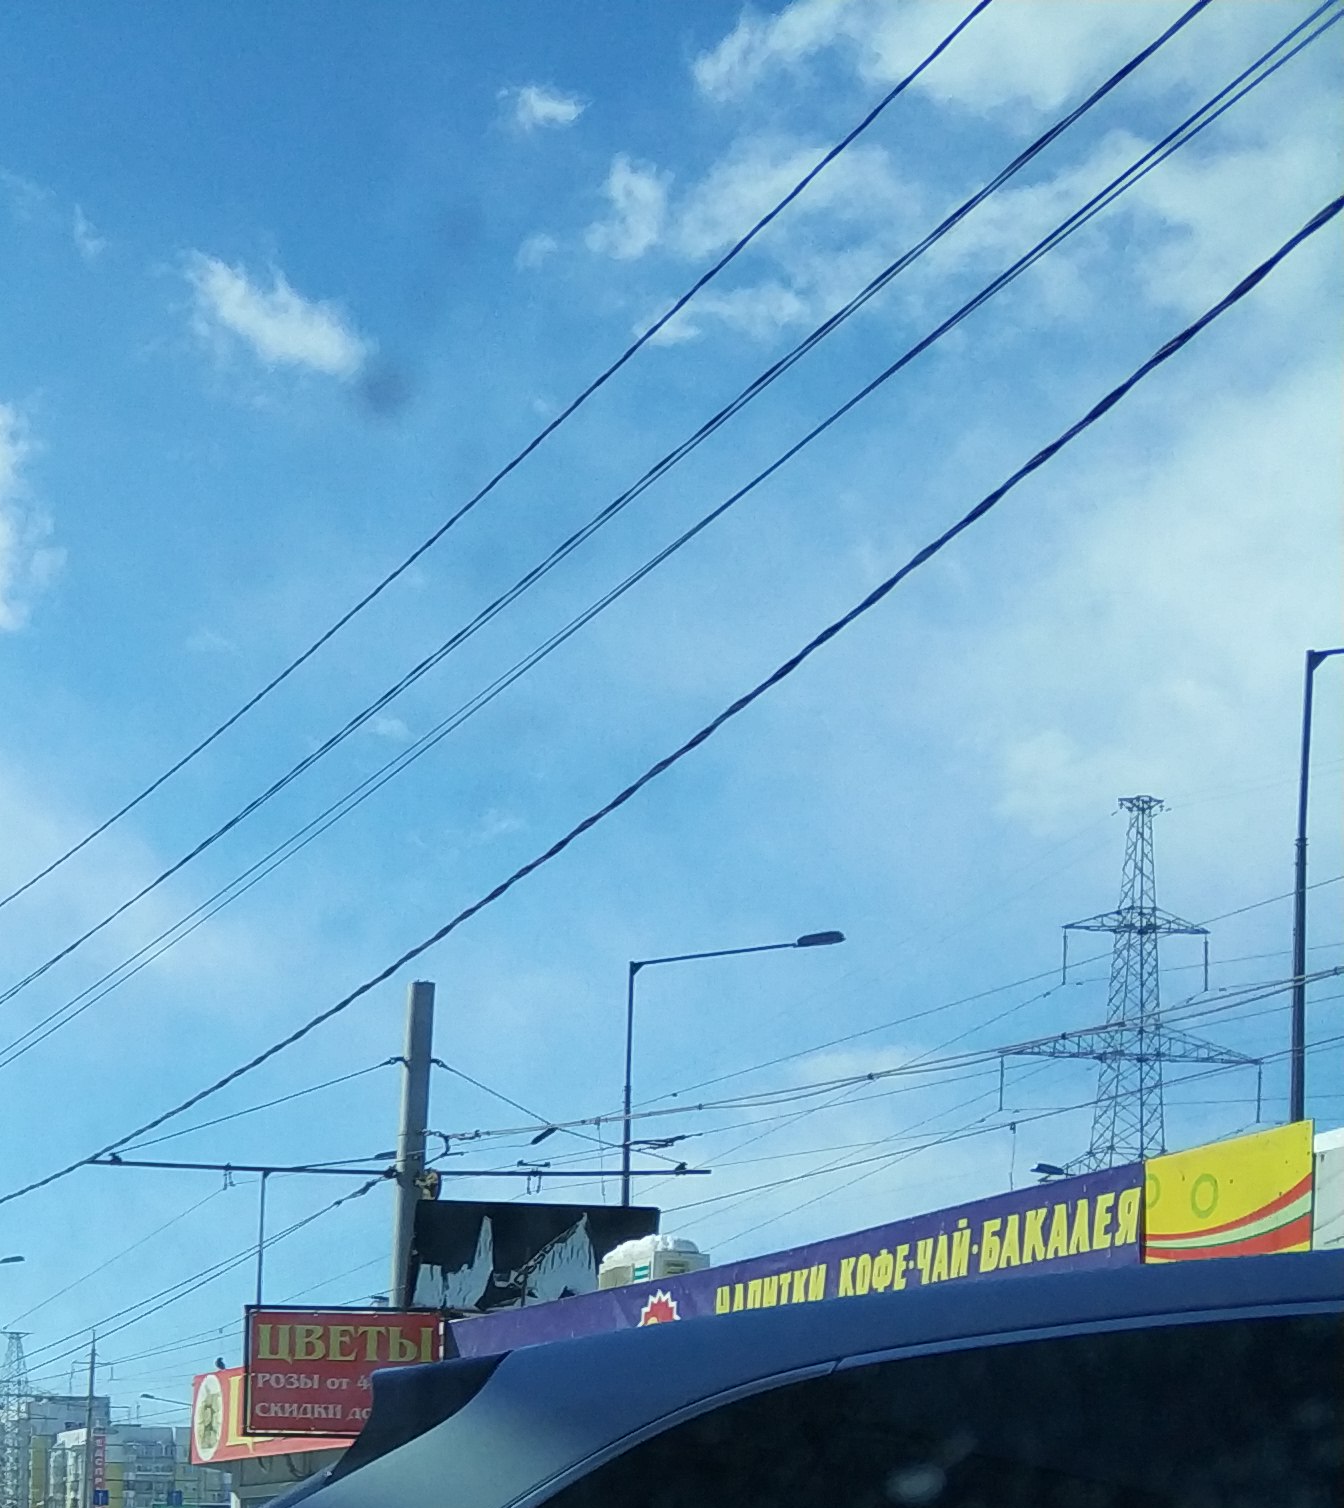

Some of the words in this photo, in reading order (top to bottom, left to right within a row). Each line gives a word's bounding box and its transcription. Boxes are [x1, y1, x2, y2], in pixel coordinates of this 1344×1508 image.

[838, 1243, 910, 1297] КОФЕ
[917, 1218, 972, 1285] ЧАЙ
[979, 1187, 1141, 1273] БАКАЛЕЯ
[257, 1323, 433, 1364] ЦВЕТЫ
[257, 1373, 320, 1389] РОЗЫ
[326, 1378, 351, 1390] от
[255, 1402, 343, 1421] СКИДКИ
